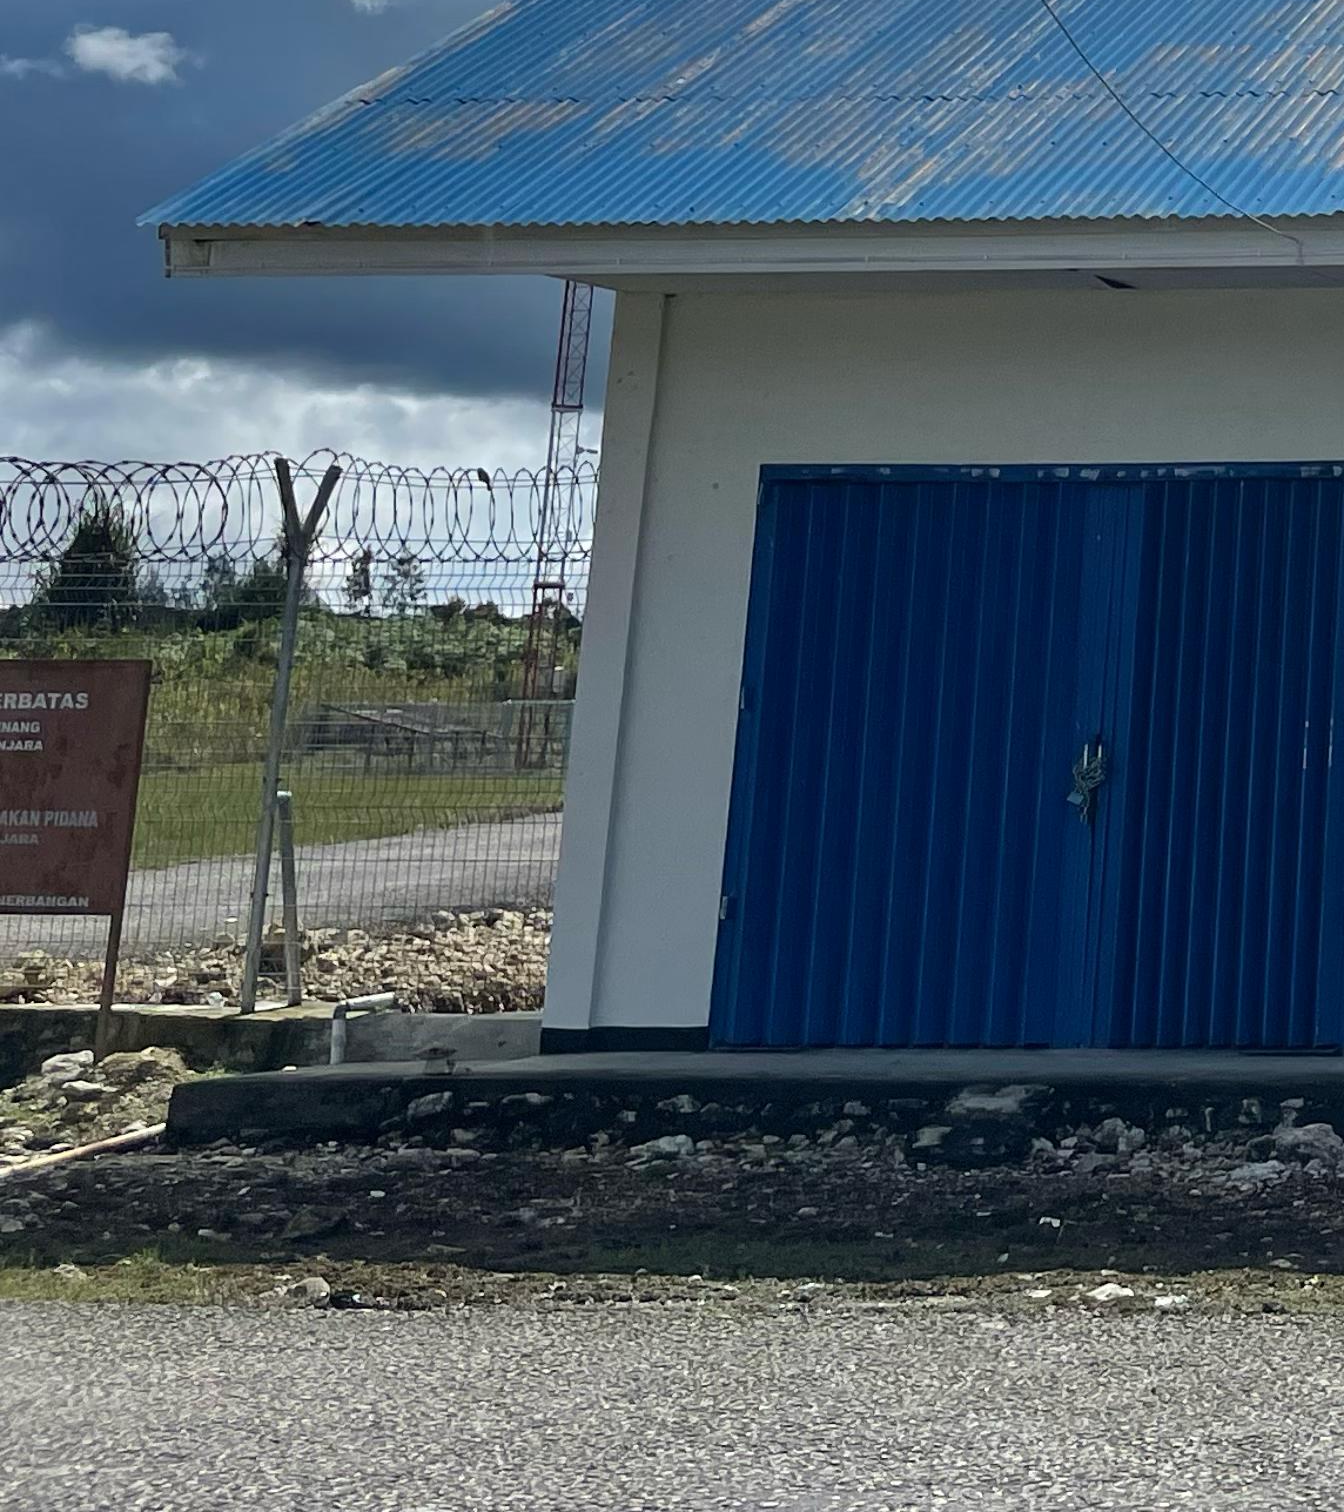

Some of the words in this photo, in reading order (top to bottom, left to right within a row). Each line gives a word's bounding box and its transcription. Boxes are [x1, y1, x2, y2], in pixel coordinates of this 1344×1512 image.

[0, 692, 89, 709] RBATAS
[0, 721, 41, 733] NANG
[44, 810, 98, 828] PIDANA
